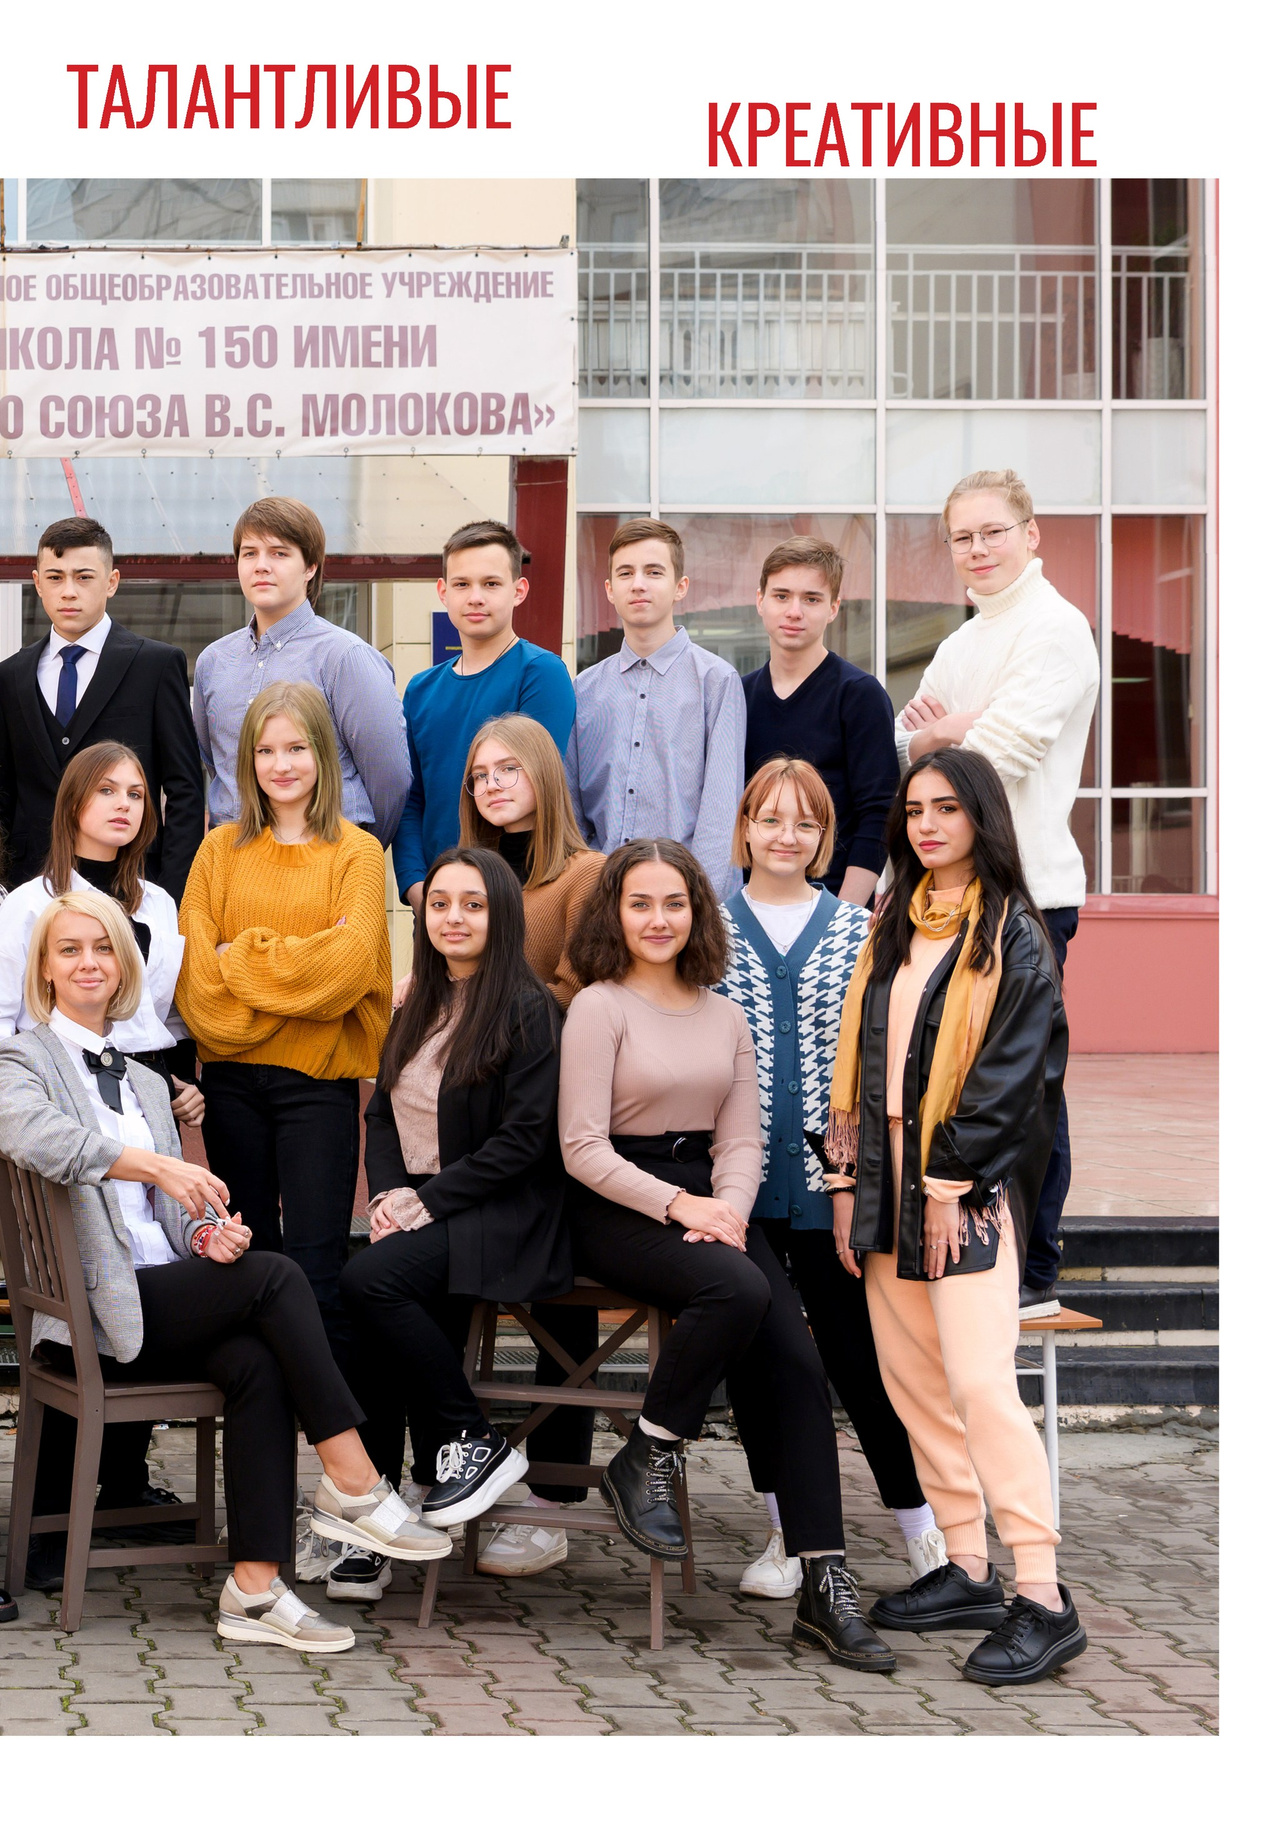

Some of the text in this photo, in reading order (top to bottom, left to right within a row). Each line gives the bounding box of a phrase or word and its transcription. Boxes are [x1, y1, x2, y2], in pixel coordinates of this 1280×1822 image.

[45, 272, 373, 305] ОБЩЕОБРАЗОВАТЕЛЬНОЕ
[382, 271, 555, 303] УЧРЕЖДЕНИЕ
[135, 327, 181, 370] №
[198, 325, 278, 369] 150
[293, 324, 437, 369] ИМЕНИ
[39, 393, 190, 440] СОЮЗА
[205, 393, 286, 438] В.С.
[301, 392, 556, 438] МОЛОКОВА»
